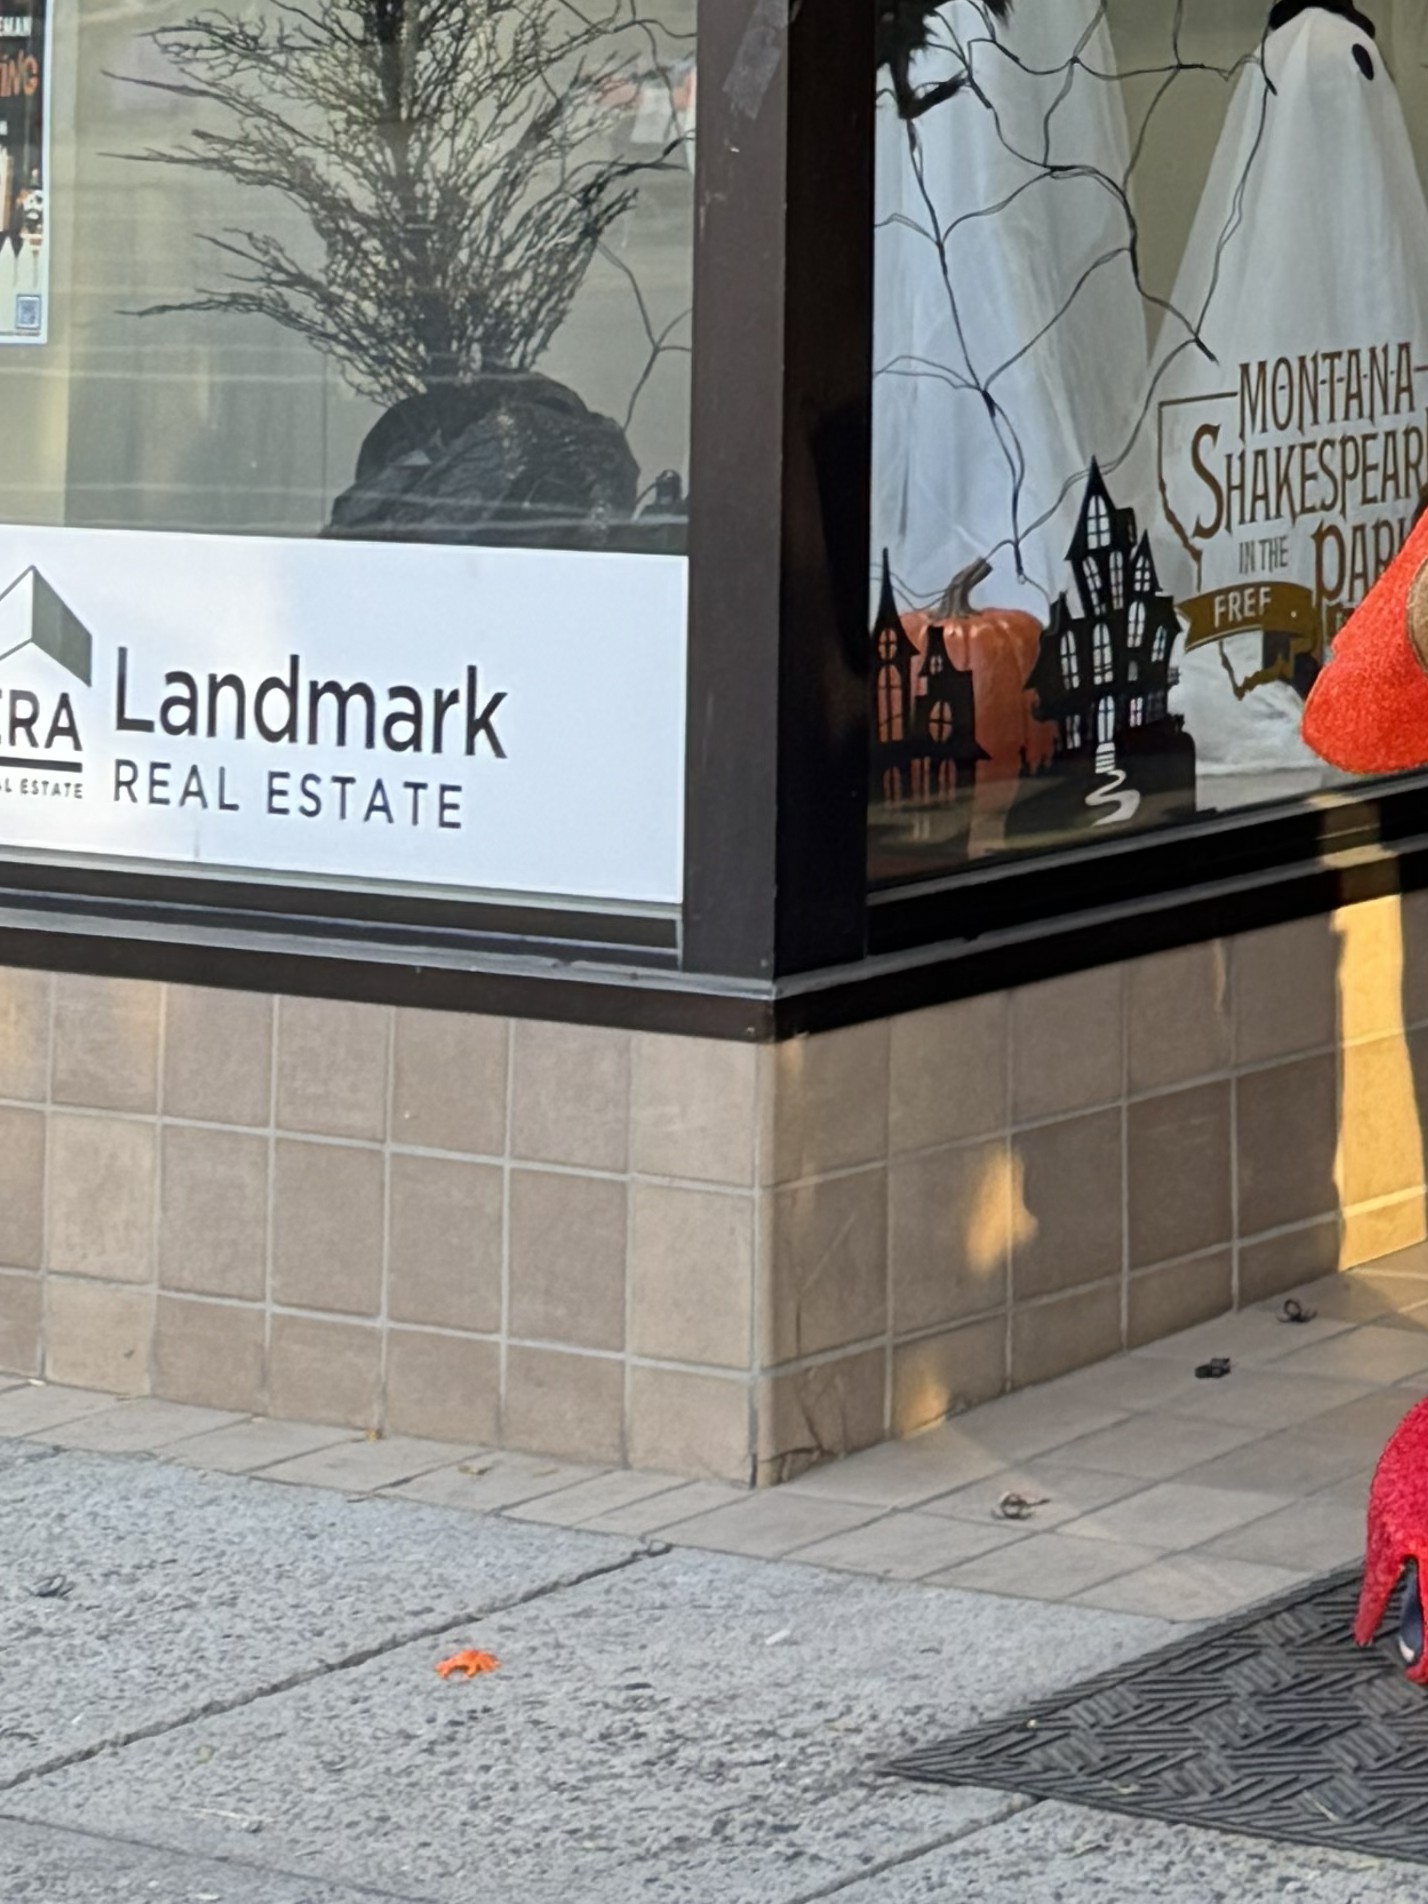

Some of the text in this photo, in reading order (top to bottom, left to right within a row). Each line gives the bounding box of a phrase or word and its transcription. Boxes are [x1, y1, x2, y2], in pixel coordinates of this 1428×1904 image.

[1238, 342, 1416, 442] MONTANA
[1238, 535, 1289, 575] IN THE
[1310, 518, 1408, 606] PAR
[0, 688, 83, 752] RA
[115, 646, 508, 759] Landmark
[20, 778, 83, 800] ESTATE
[113, 758, 463, 830] REAL ESTATE
